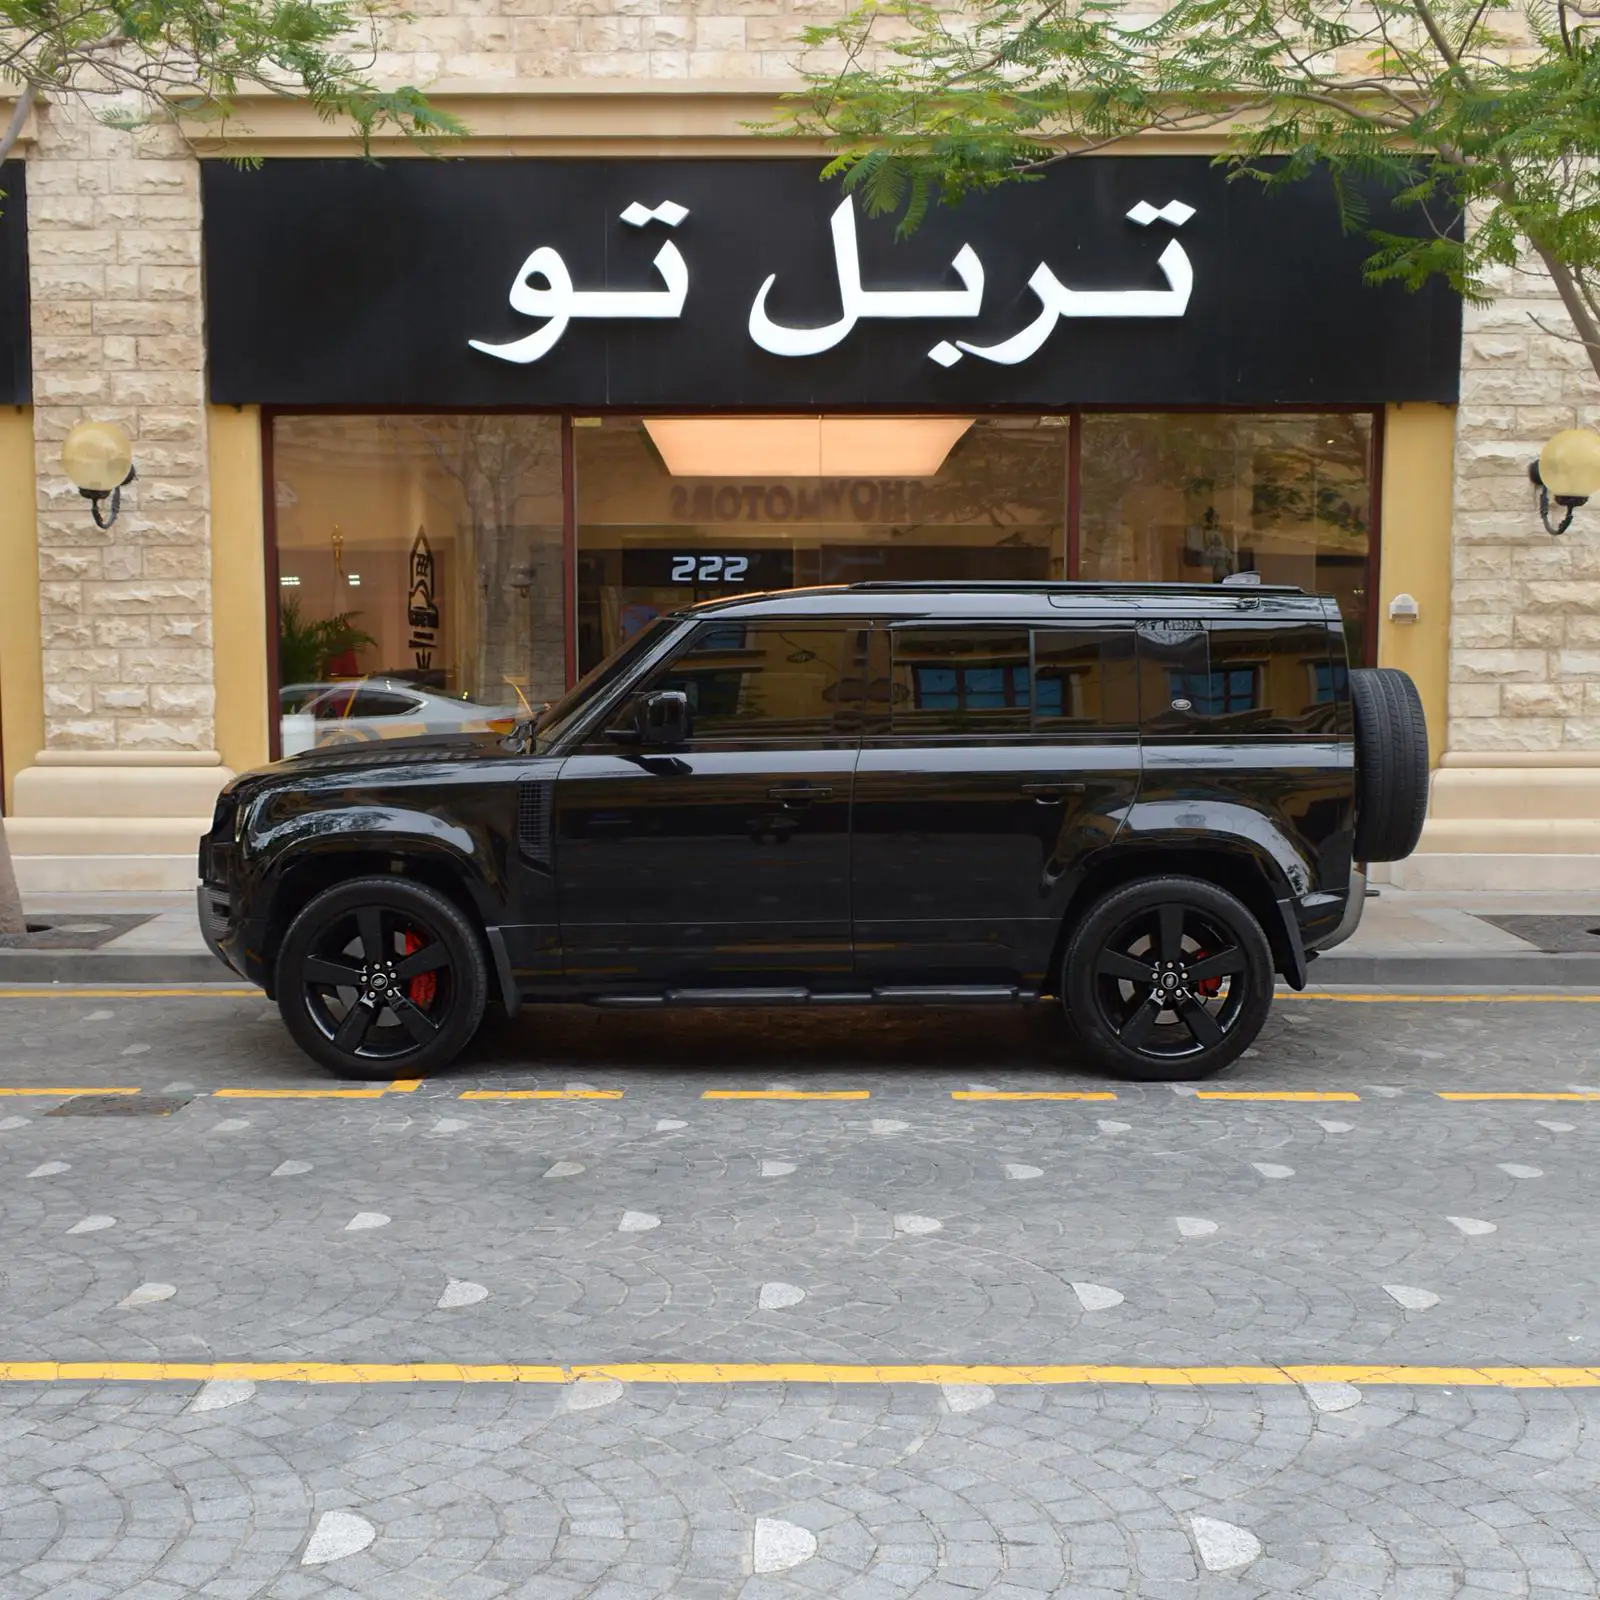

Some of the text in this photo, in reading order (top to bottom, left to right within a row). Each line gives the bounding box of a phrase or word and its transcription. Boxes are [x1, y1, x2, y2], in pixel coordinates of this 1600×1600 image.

[469, 195, 1196, 367] تربل تو
[672, 556, 748, 581] 222
